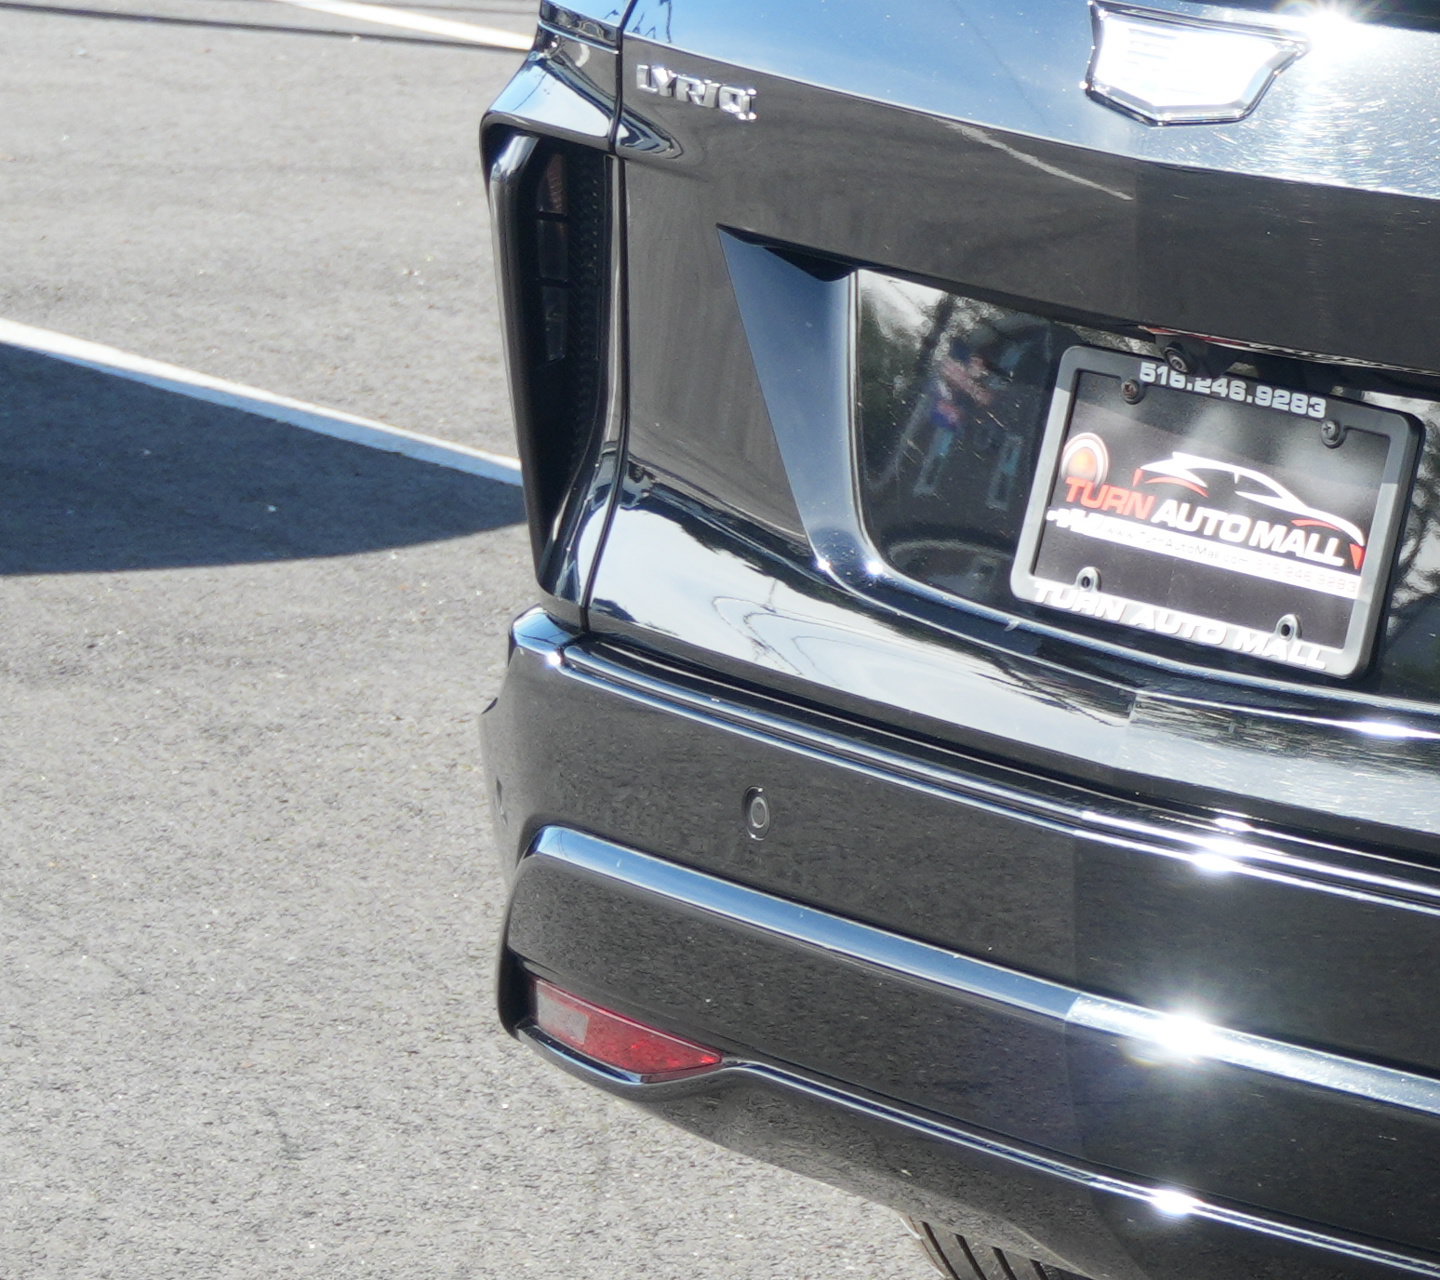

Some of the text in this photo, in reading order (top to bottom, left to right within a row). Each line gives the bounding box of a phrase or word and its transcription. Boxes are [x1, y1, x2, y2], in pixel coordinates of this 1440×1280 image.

[636, 64, 758, 122] LYRIQ
[1139, 362, 1327, 419] 516.246.9283
[1065, 476, 1346, 567] TURN AUTO MALL
[1034, 582, 1327, 670] TURN AUTO MALL
